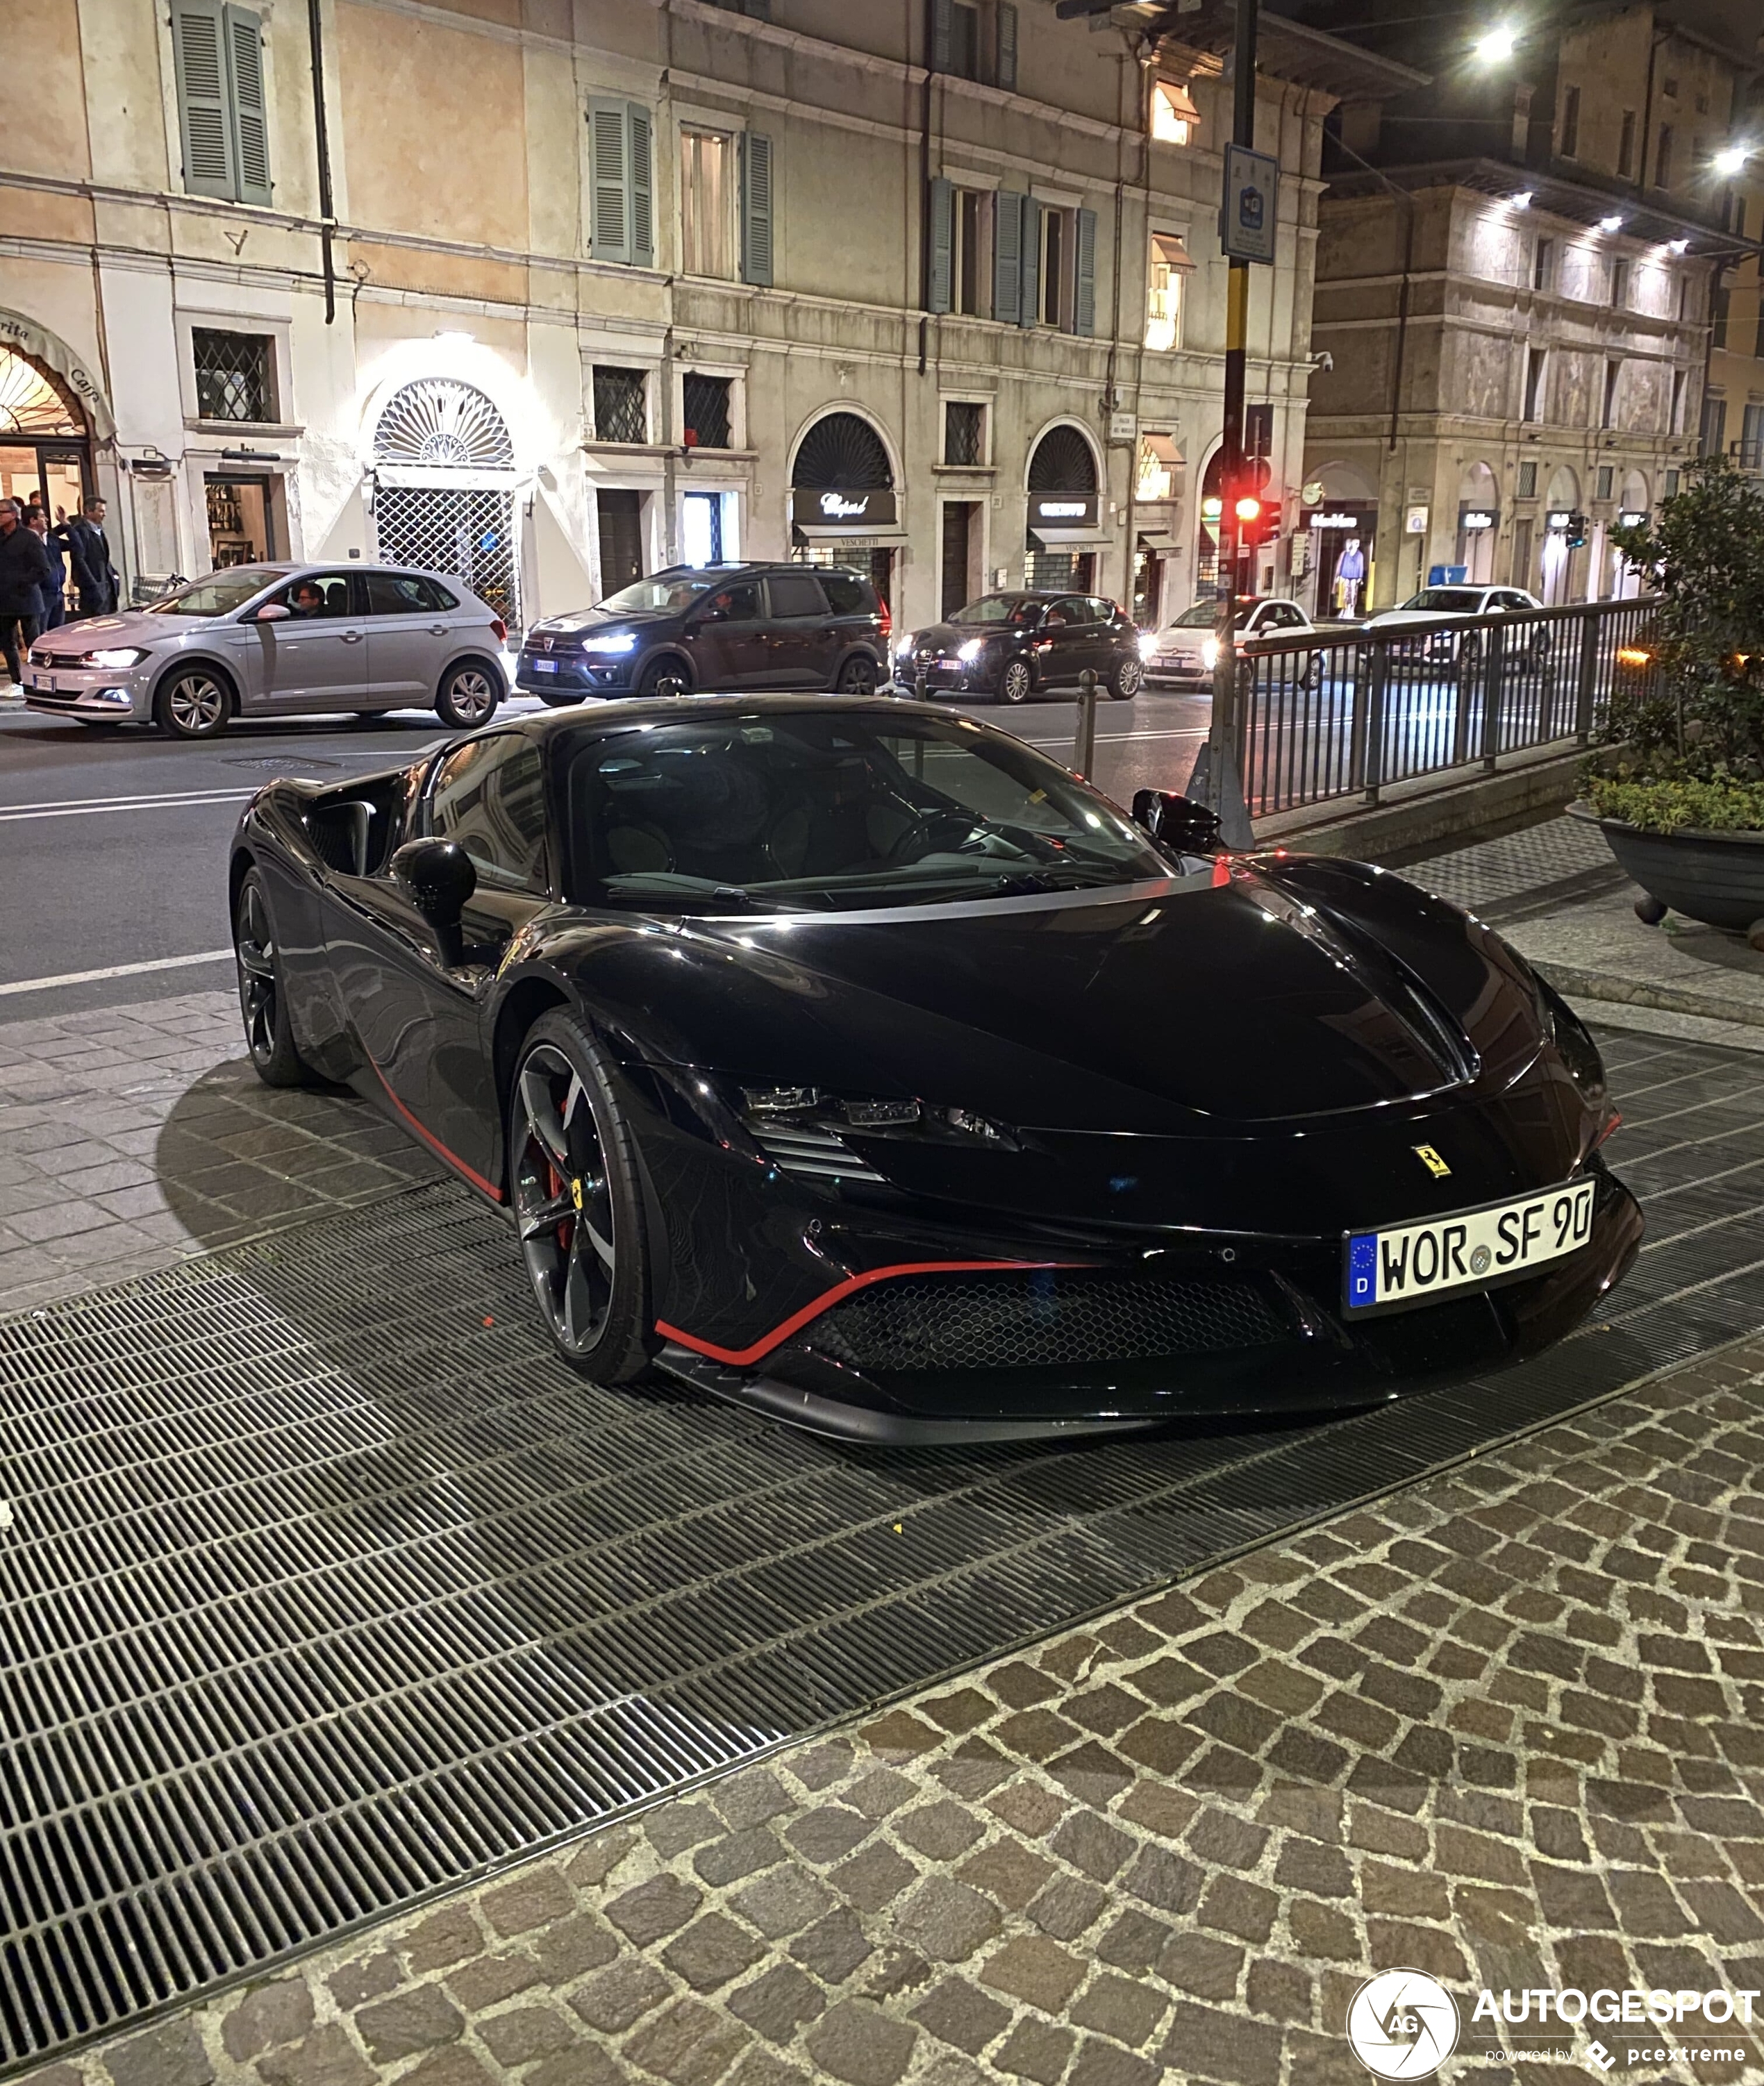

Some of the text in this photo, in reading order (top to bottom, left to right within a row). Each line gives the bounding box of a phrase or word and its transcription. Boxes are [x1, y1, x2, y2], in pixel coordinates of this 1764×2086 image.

[841, 538, 879, 546] VESCHETTI
[1381, 1189, 1590, 1293] WOR SF 90
[1356, 1278, 1368, 1294] D
